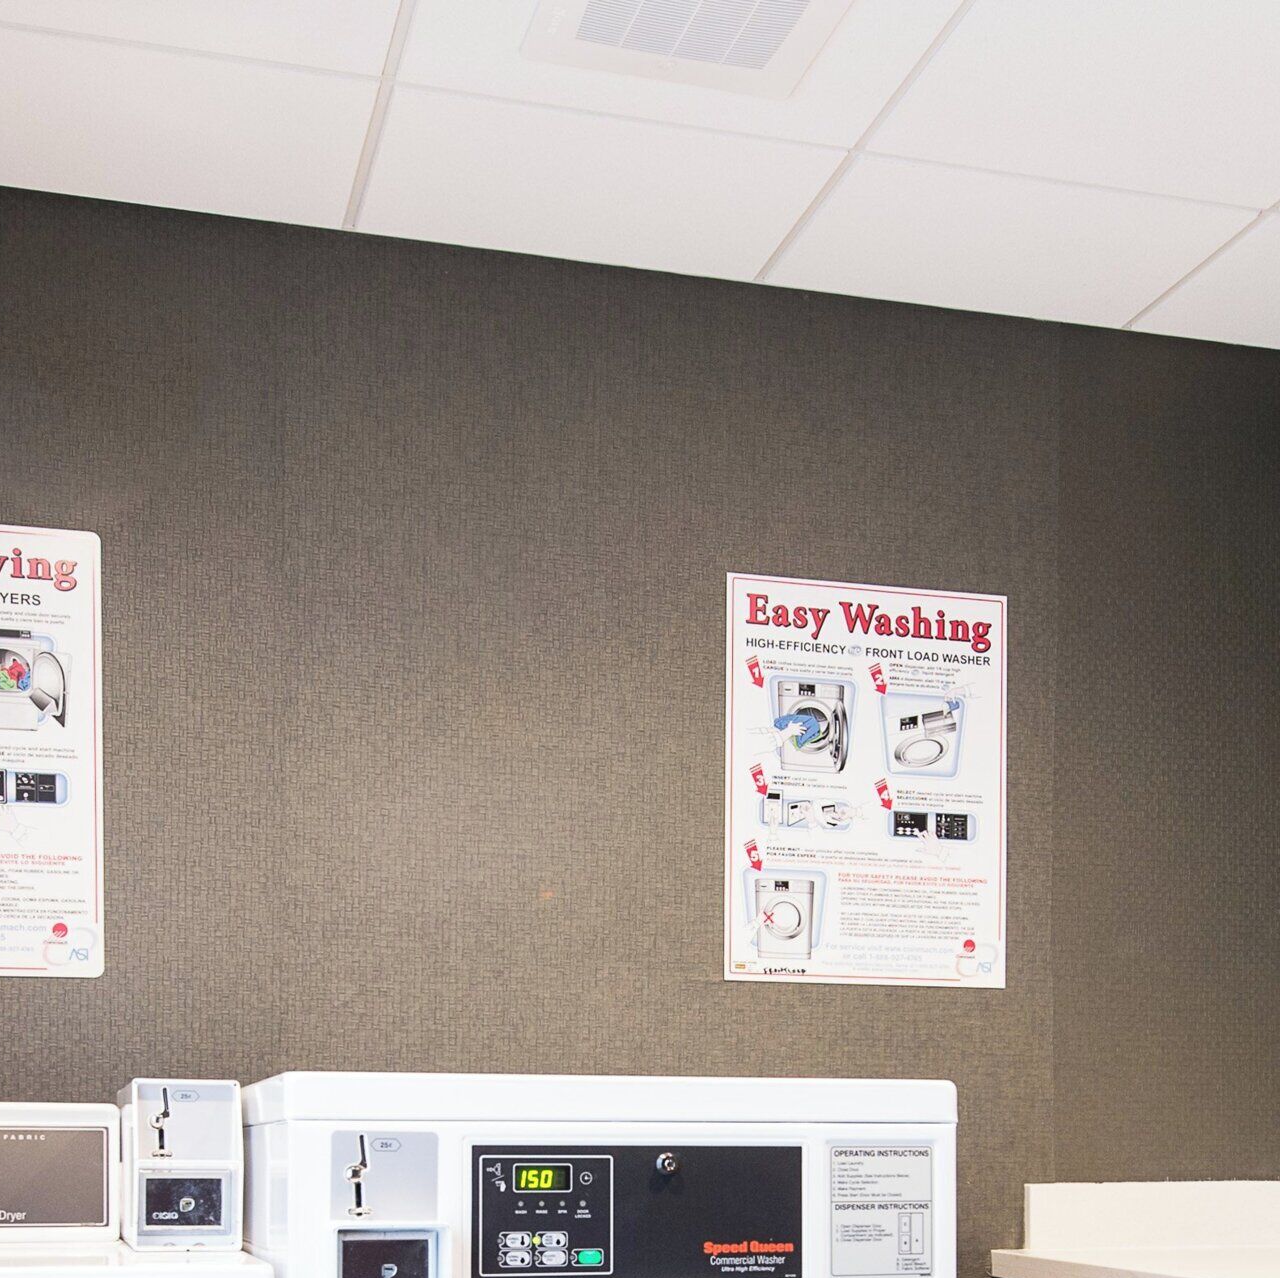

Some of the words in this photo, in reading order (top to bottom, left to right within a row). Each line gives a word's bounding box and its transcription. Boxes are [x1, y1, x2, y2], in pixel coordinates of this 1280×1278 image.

[746, 593, 830, 640] Easy
[838, 601, 992, 653] Washing
[746, 638, 846, 655] HIGH-EFFICIENCY
[865, 648, 904, 659] FRONT
[908, 651, 939, 662] LOAD
[942, 654, 991, 666] WASHER
[38, 853, 82, 861] FOLLOWING
[750, 850, 760, 862] 5
[520, 1170, 553, 1188] 150
[703, 1241, 748, 1256] Speed
[750, 1240, 794, 1252] Queen
[710, 1255, 756, 1265] Commercial
[757, 1255, 786, 1264] Washer
